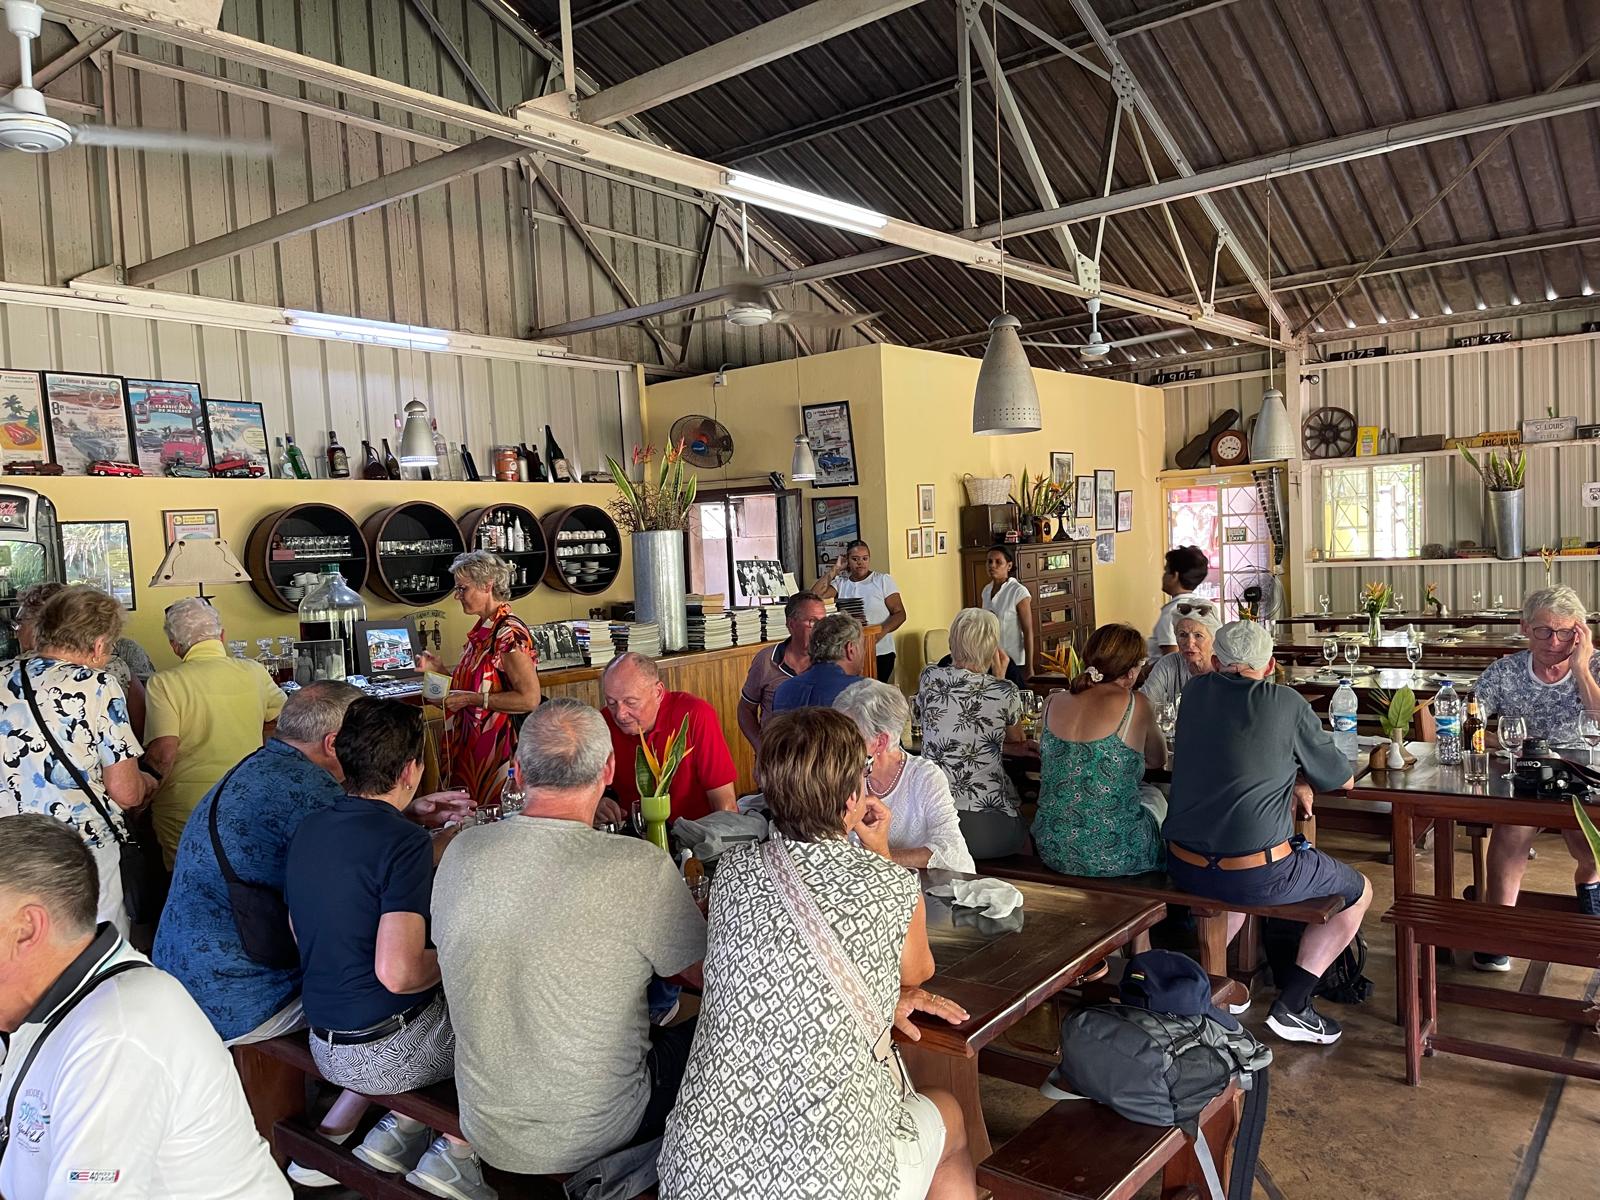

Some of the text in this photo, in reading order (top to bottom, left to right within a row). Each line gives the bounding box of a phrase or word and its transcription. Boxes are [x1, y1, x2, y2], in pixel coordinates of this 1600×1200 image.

[1340, 348, 1376, 361] 1075
[1169, 370, 1196, 382] 905
[1543, 422, 1565, 431] LOUIS
